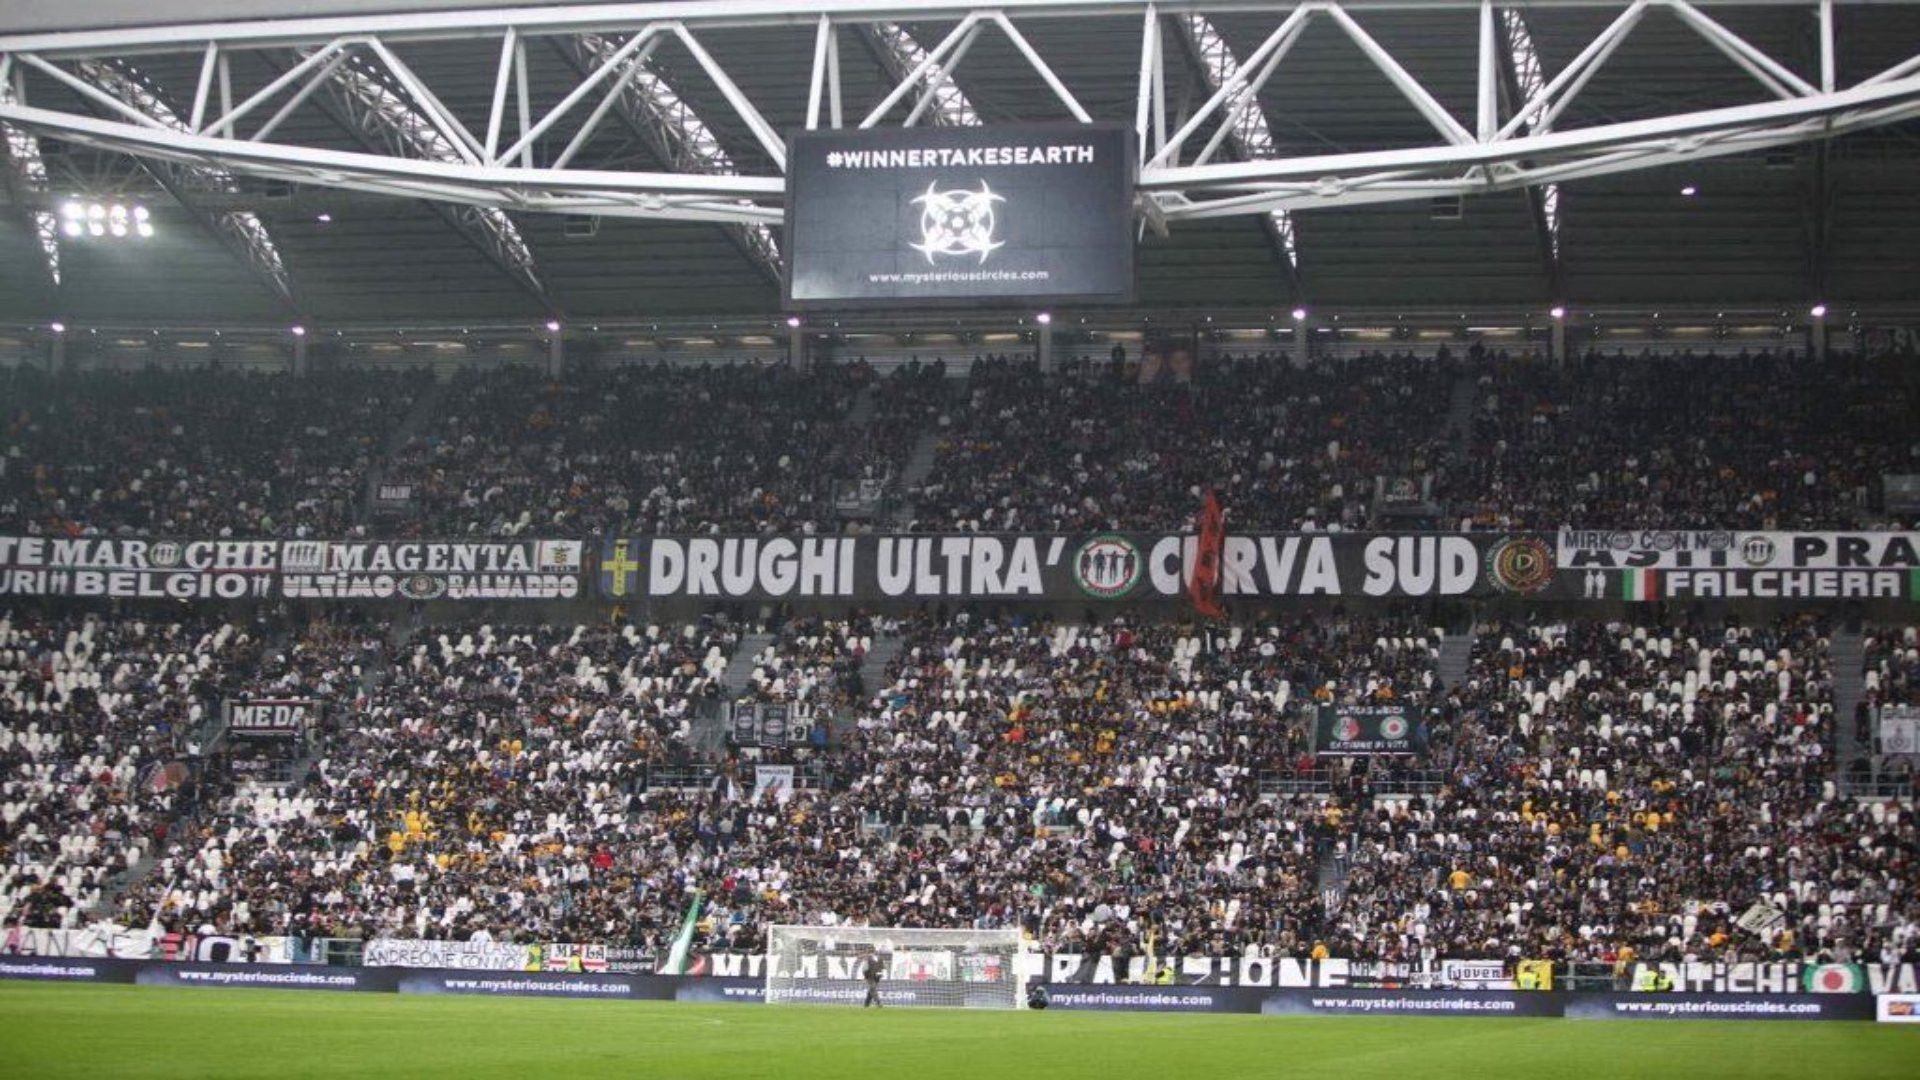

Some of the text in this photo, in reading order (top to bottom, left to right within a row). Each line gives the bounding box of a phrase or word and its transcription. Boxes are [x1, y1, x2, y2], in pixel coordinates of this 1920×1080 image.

[826, 146, 1094, 169] #WINNERTAKESEARTH
[869, 269, 1049, 285] www.mysteriouscircles.com
[330, 543, 531, 572] MAGENTA
[1793, 536, 1920, 567] PRA
[649, 537, 856, 596] DRUGHI
[1364, 536, 1479, 595] SUD
[74, 571, 249, 598] BELGIO
[1666, 571, 1900, 597] FALCHERA
[232, 705, 305, 727] MEDA
[178, 970, 356, 985] www.mysteriouscircles.com
[444, 978, 631, 993] www.mysteriouscircles.com
[1052, 992, 1213, 1007] mysteriouscircles.com
[1312, 997, 1516, 1011] www.mysteriouscircles.com
[1616, 1001, 1821, 1014] www.mysteriouscircles.com
